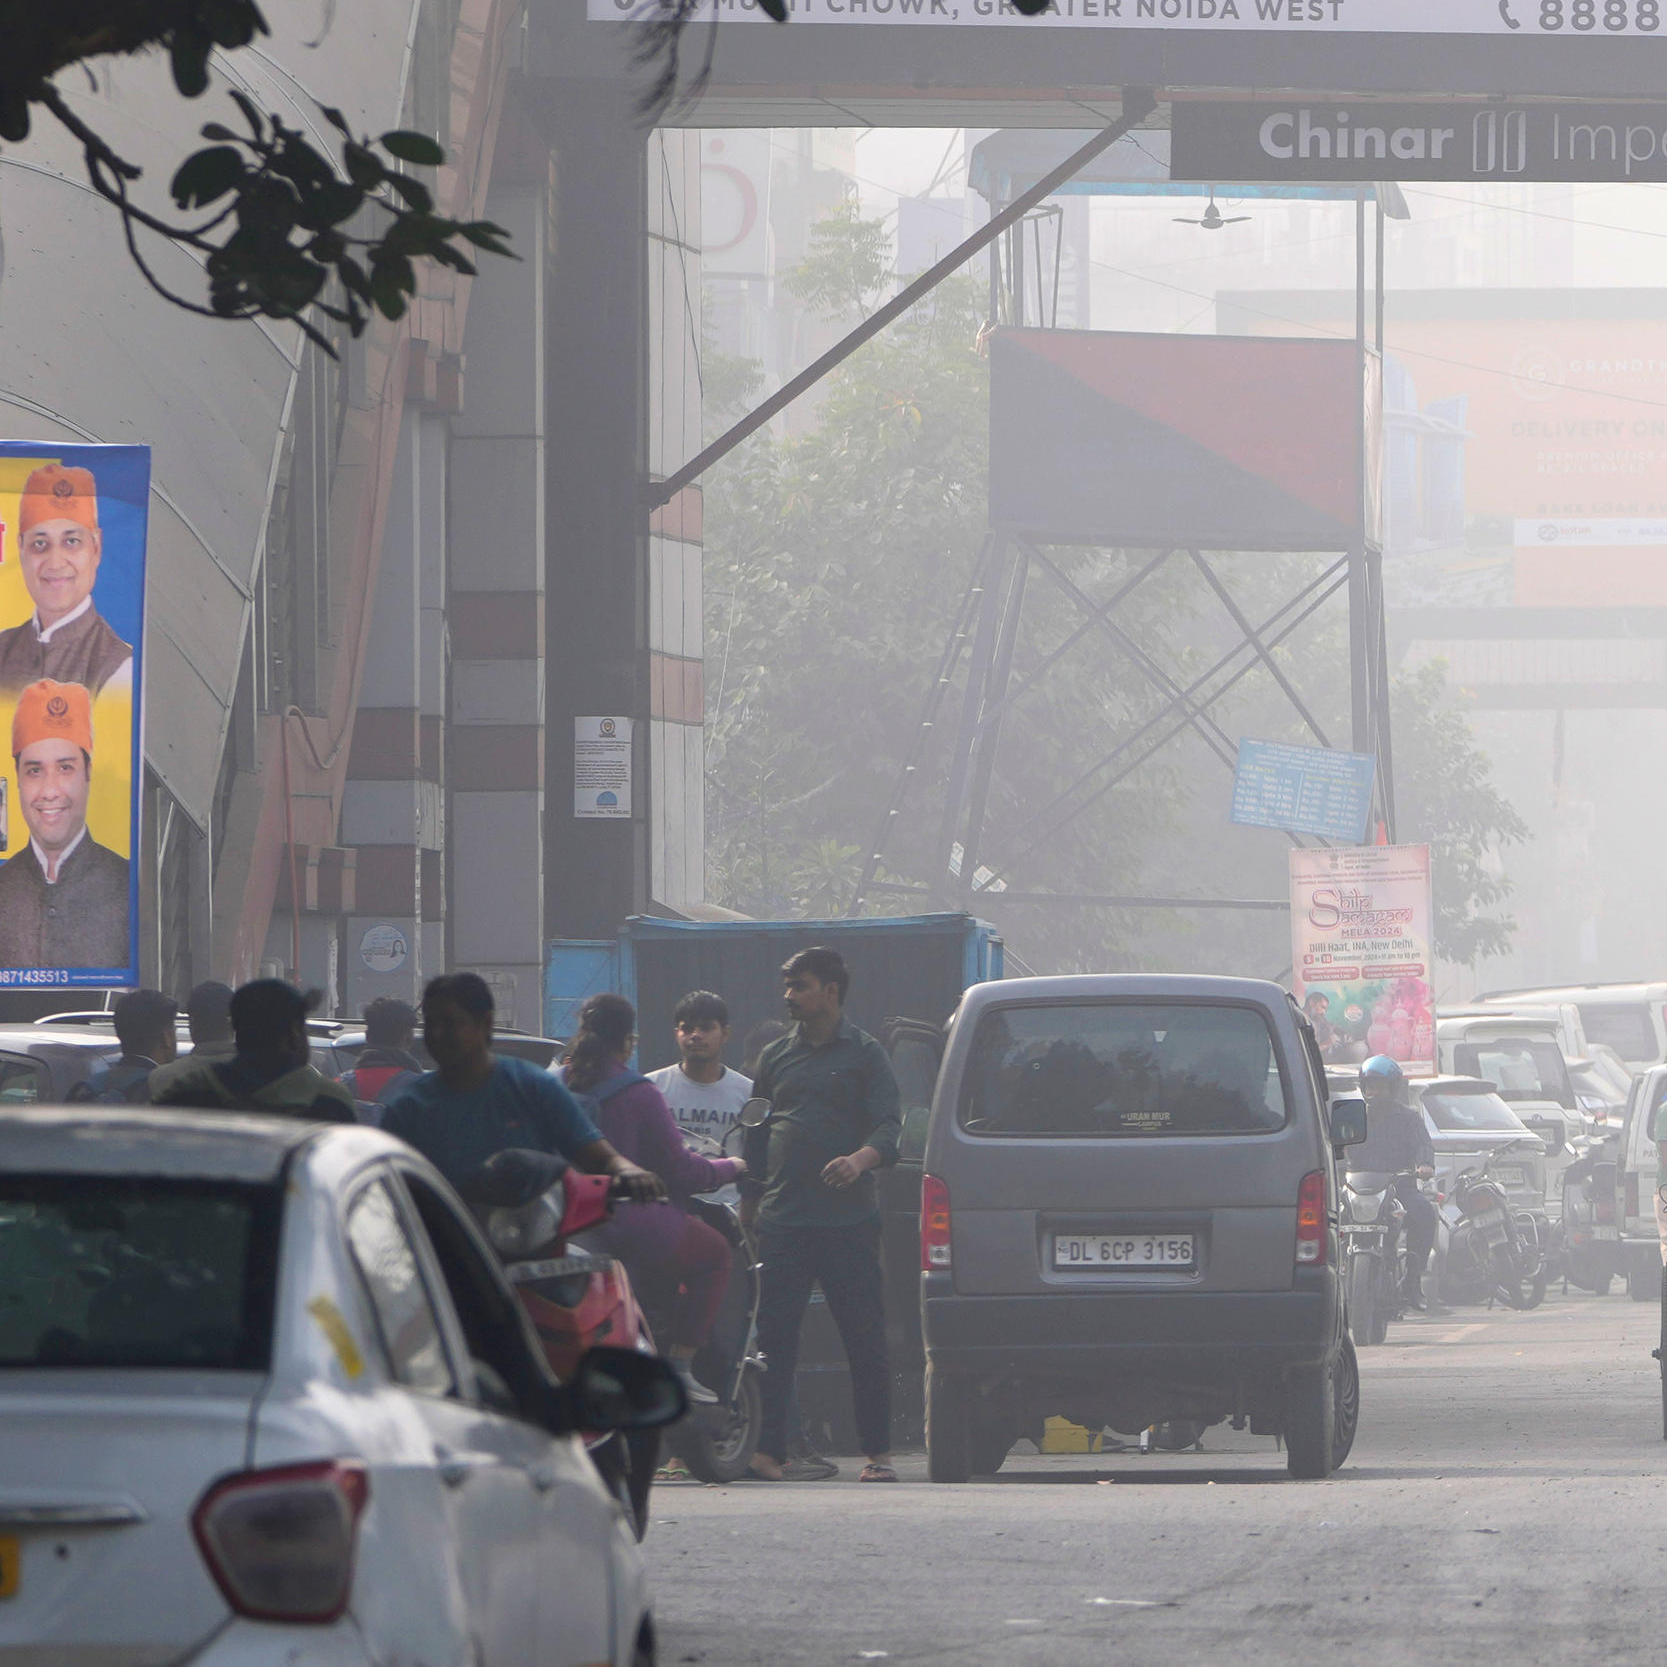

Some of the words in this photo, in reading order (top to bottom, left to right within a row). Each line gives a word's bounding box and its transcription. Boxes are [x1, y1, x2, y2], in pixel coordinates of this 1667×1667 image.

[1258, 111, 1455, 160] Chinar
[1341, 928, 1371, 937] MELA
[1373, 926, 1401, 935] 2024
[1371, 940, 1390, 950] New
[1391, 938, 1413, 950] Delhi
[0, 970, 69, 983] 871435513
[1069, 1241, 1093, 1262] DL
[1100, 1241, 1136, 1262] 6CP
[1143, 1240, 1192, 1261] 3156
